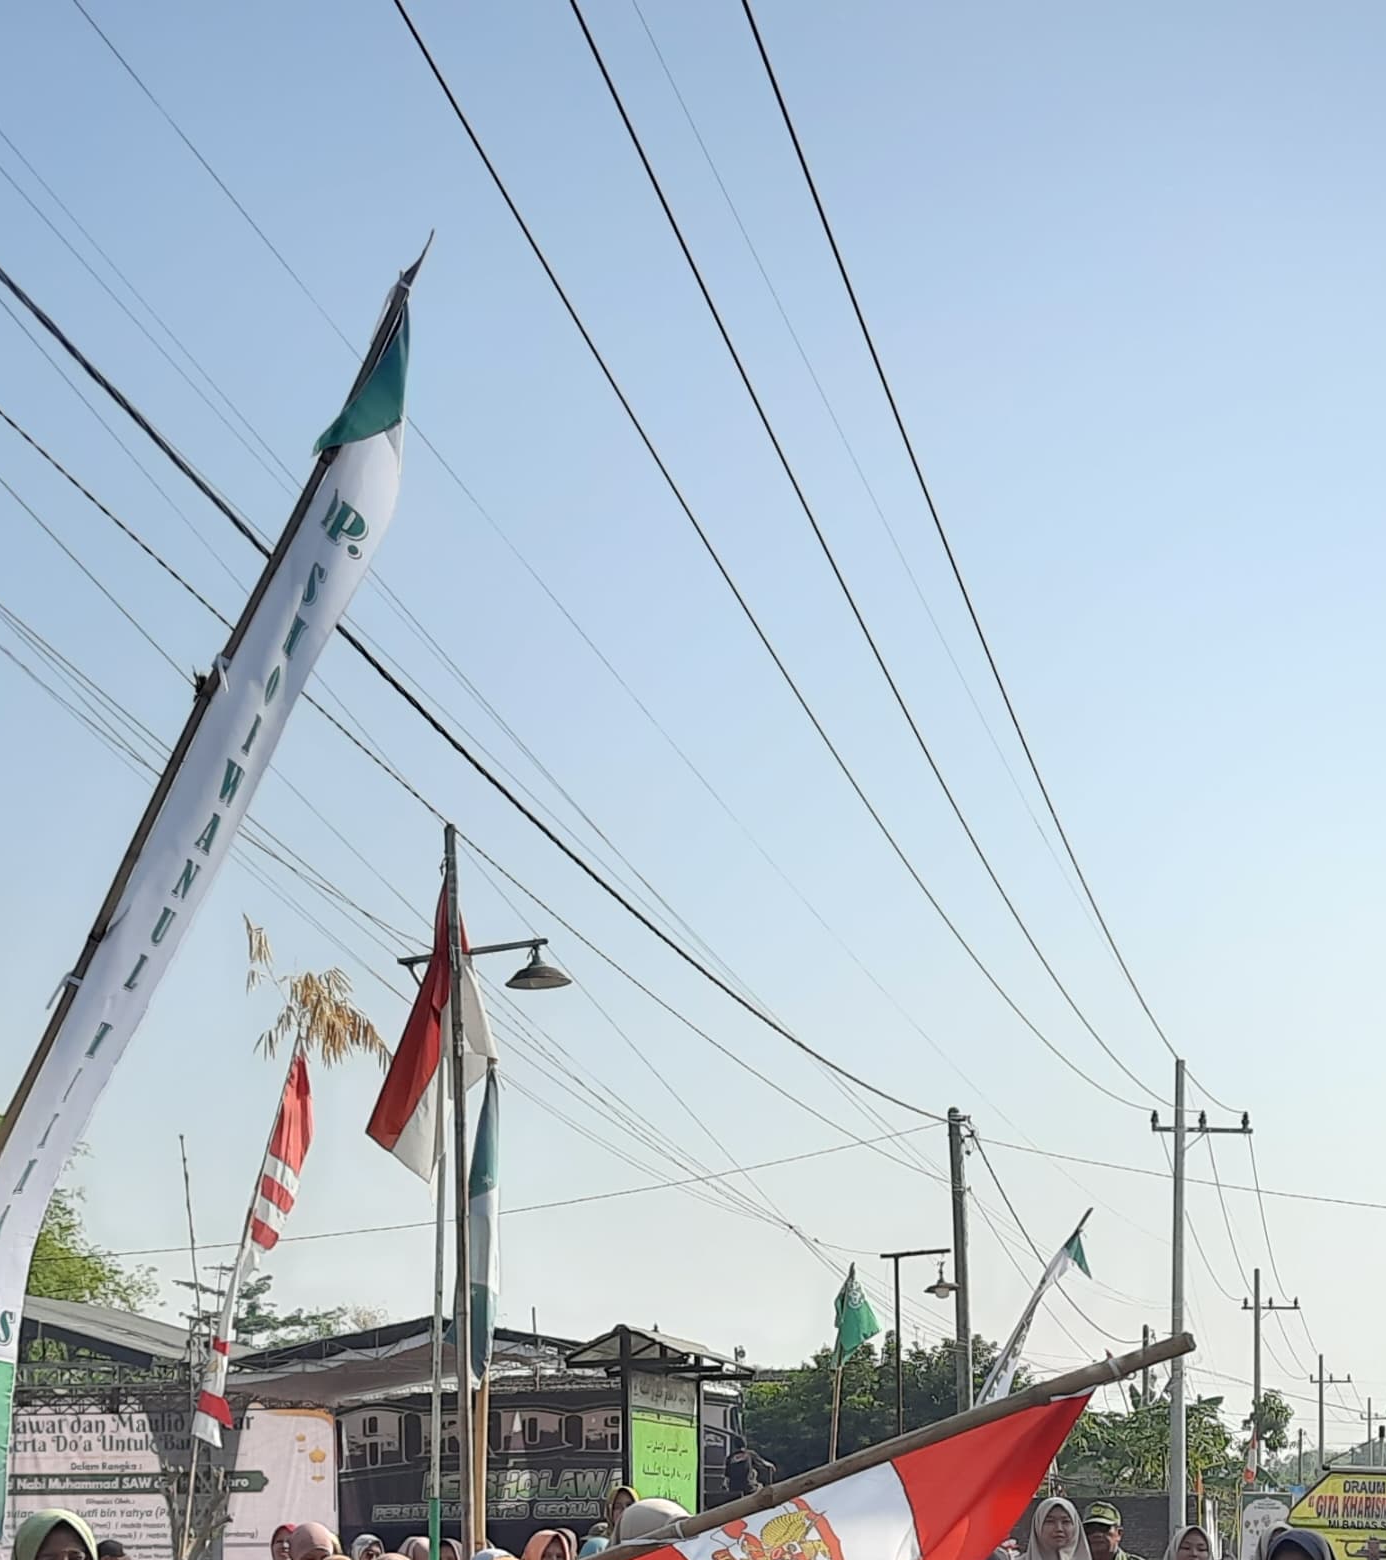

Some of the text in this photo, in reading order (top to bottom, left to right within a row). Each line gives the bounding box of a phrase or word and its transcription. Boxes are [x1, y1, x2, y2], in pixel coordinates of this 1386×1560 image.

[70, 1415, 106, 1435] dan
[17, 1479, 46, 1490] Nabi
[48, 1477, 119, 1490] Muhammad
[122, 1478, 151, 1489] SAW
[1316, 1496, 1339, 1518] GITA
